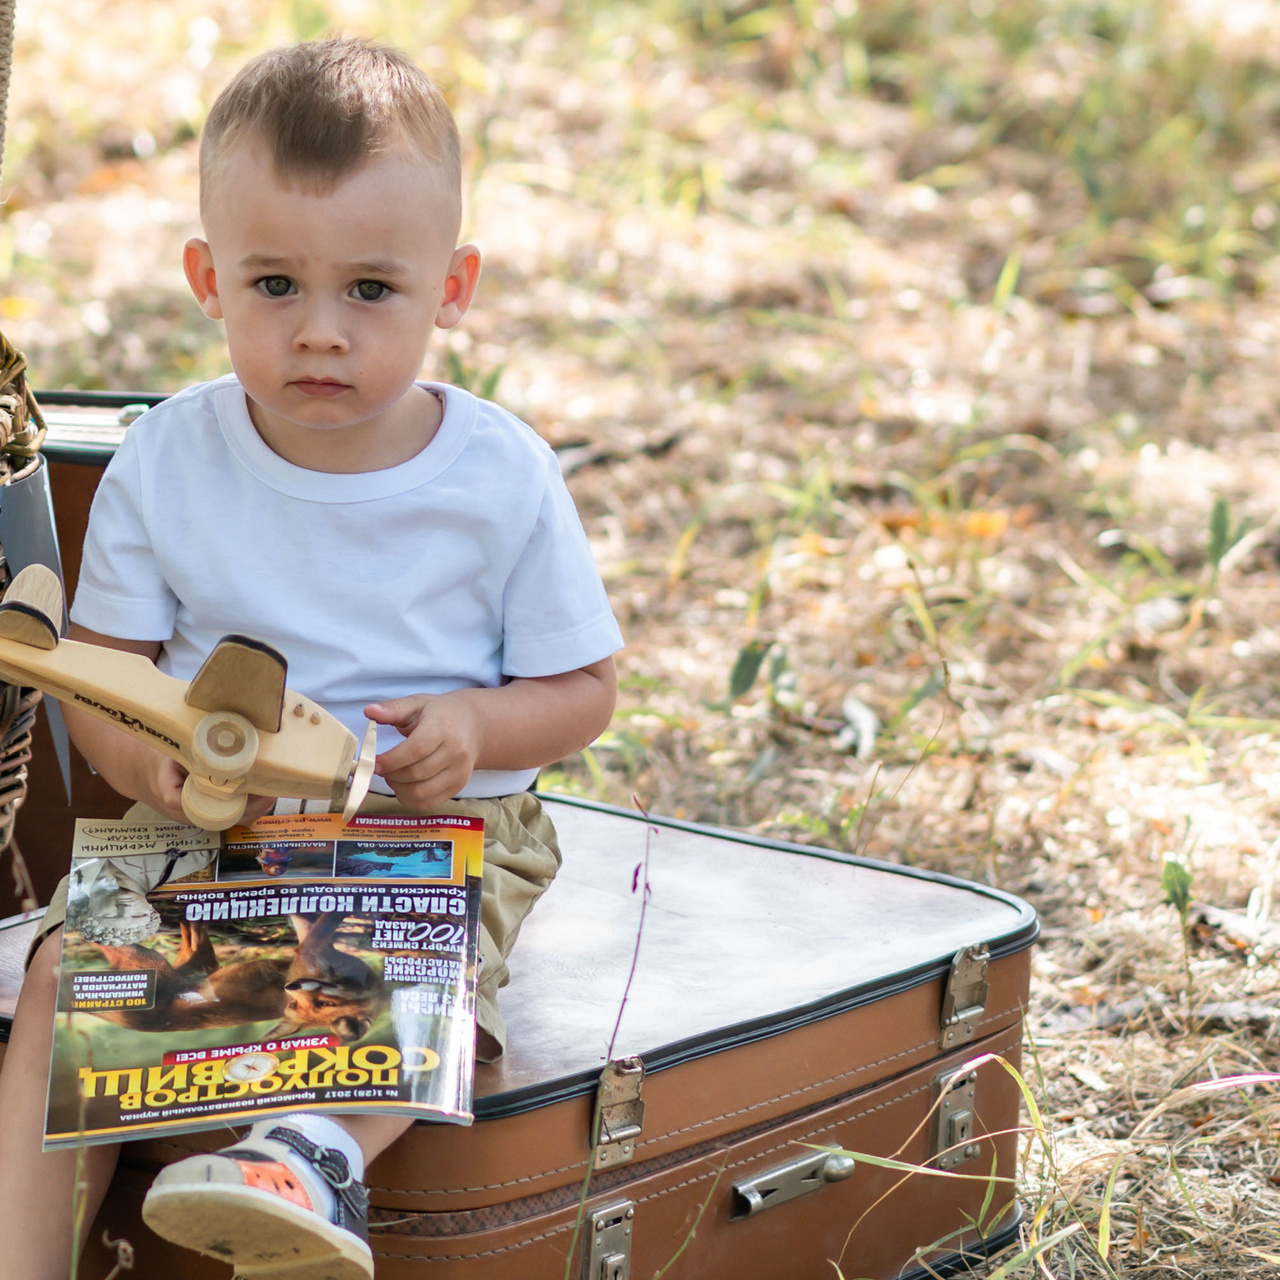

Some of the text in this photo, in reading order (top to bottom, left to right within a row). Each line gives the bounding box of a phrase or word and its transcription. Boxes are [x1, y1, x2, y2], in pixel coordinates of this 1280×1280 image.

[356, 818, 470, 826] ОТКРЫТА ПОДПИСКА!
[81, 841, 156, 852] МЕДИЦИНЫ
[230, 888, 275, 898] время
[303, 886, 386, 894] винзаводы
[391, 888, 466, 898] Крымские
[176, 893, 224, 901] войны
[186, 896, 466, 921] СПАСТИ КОЛЛЕКЦИЮ
[375, 920, 415, 929] НАЗАД
[373, 923, 464, 944] 100 ЛЕТ
[372, 941, 419, 949] СИМЕИЗ
[384, 964, 461, 978] МОРСКИЕ
[74, 974, 148, 983] ПОЛУОСТРОВЕ!
[384, 975, 460, 985] РЕДНЕВЕКОВЫЕ
[82, 982, 147, 990] МАТЕРИАЛОВ
[75, 990, 144, 999] УНИКАЛЬНЫХ
[400, 991, 439, 1002] ЛЕСА
[126, 998, 147, 1006] 100
[176, 1037, 328, 1062] УЗНАЙ О КРЫМЕ ВСЕ!
[119, 1069, 398, 1110] ПОЛУОСТРОВ
[325, 1090, 351, 1098] 2017
[353, 1089, 382, 1097] 1(28)
[257, 1091, 316, 1107] Крымский
[162, 1099, 254, 1116] познавательный
[120, 1110, 159, 1121] журнал
